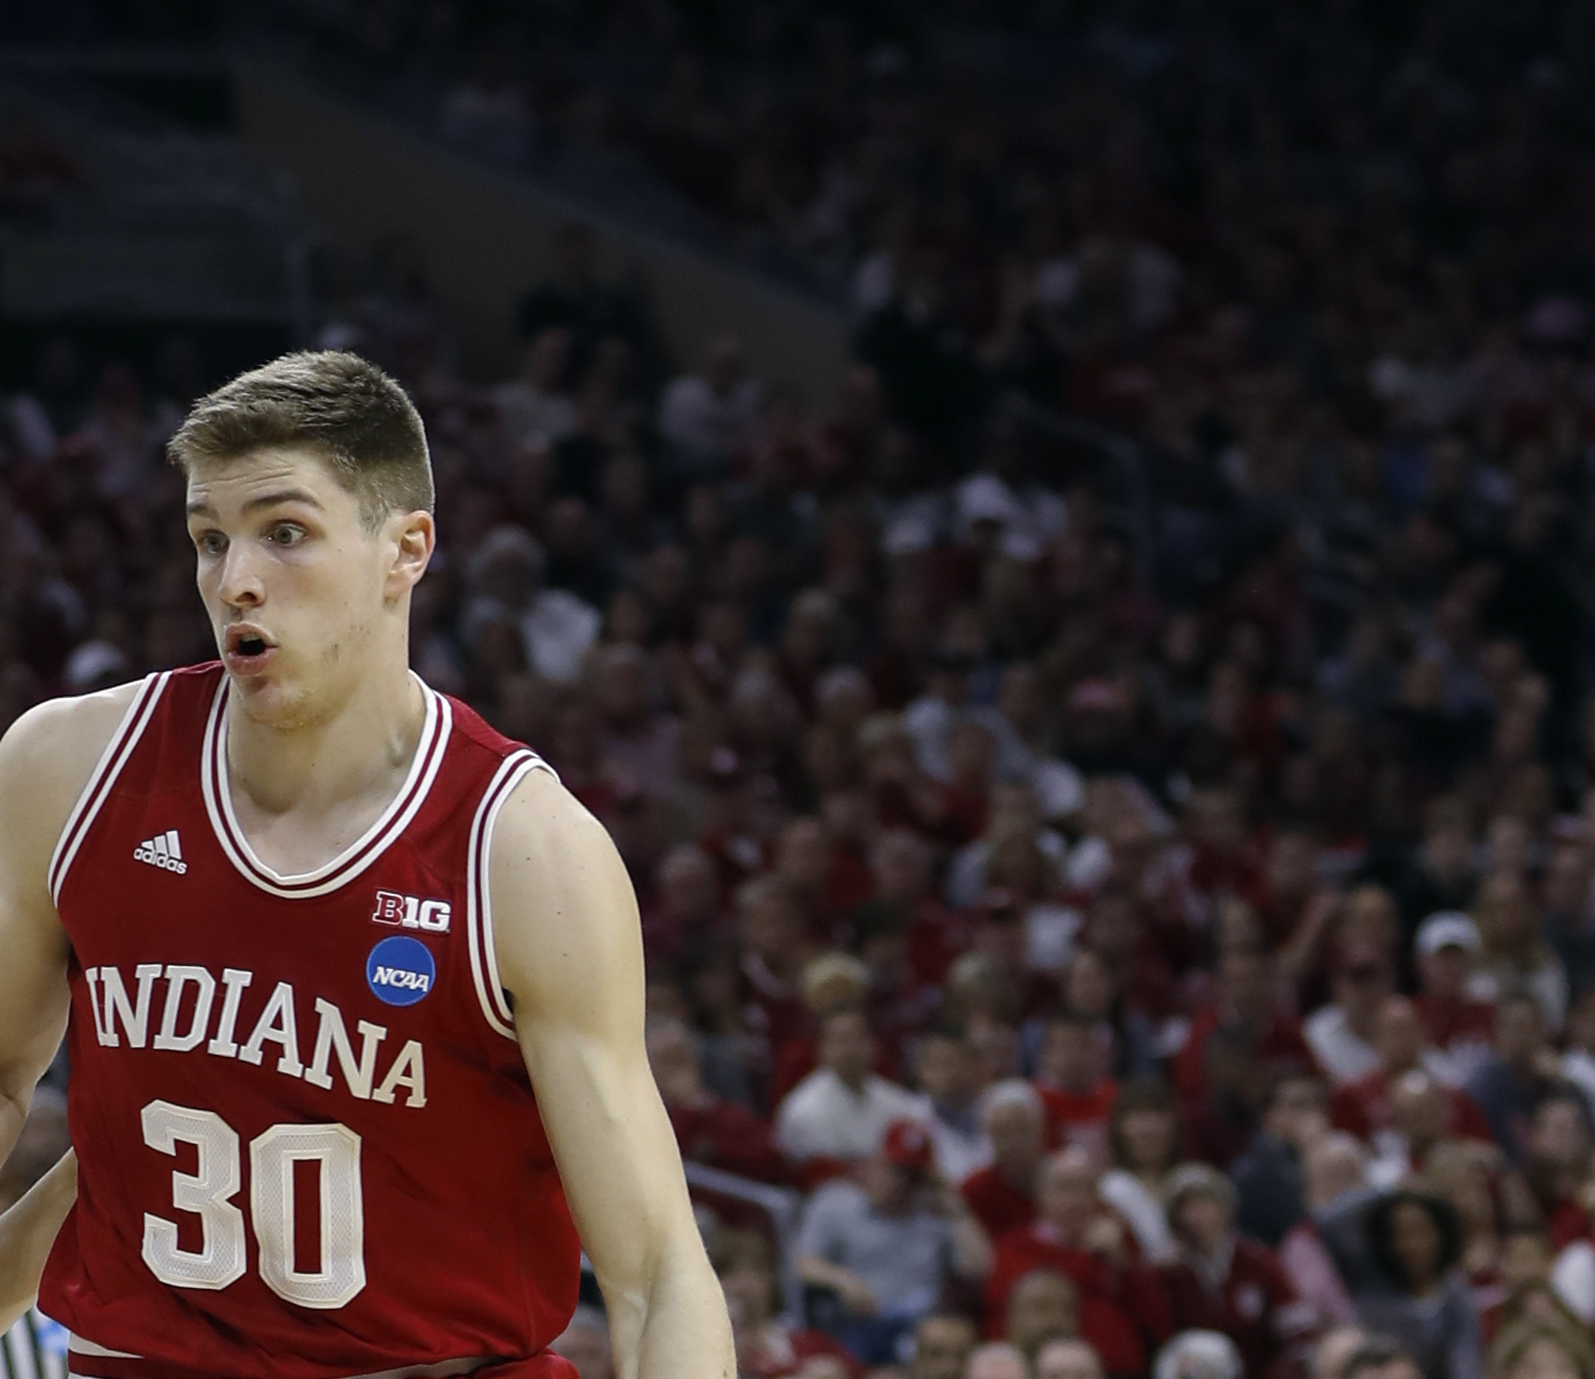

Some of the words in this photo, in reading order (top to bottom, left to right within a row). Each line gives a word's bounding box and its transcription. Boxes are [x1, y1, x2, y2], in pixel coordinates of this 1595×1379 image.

[133, 847, 188, 875] adidas
[372, 965, 430, 993] NCAA
[85, 963, 428, 1109] INDIANA
[140, 1099, 367, 1310] 30
